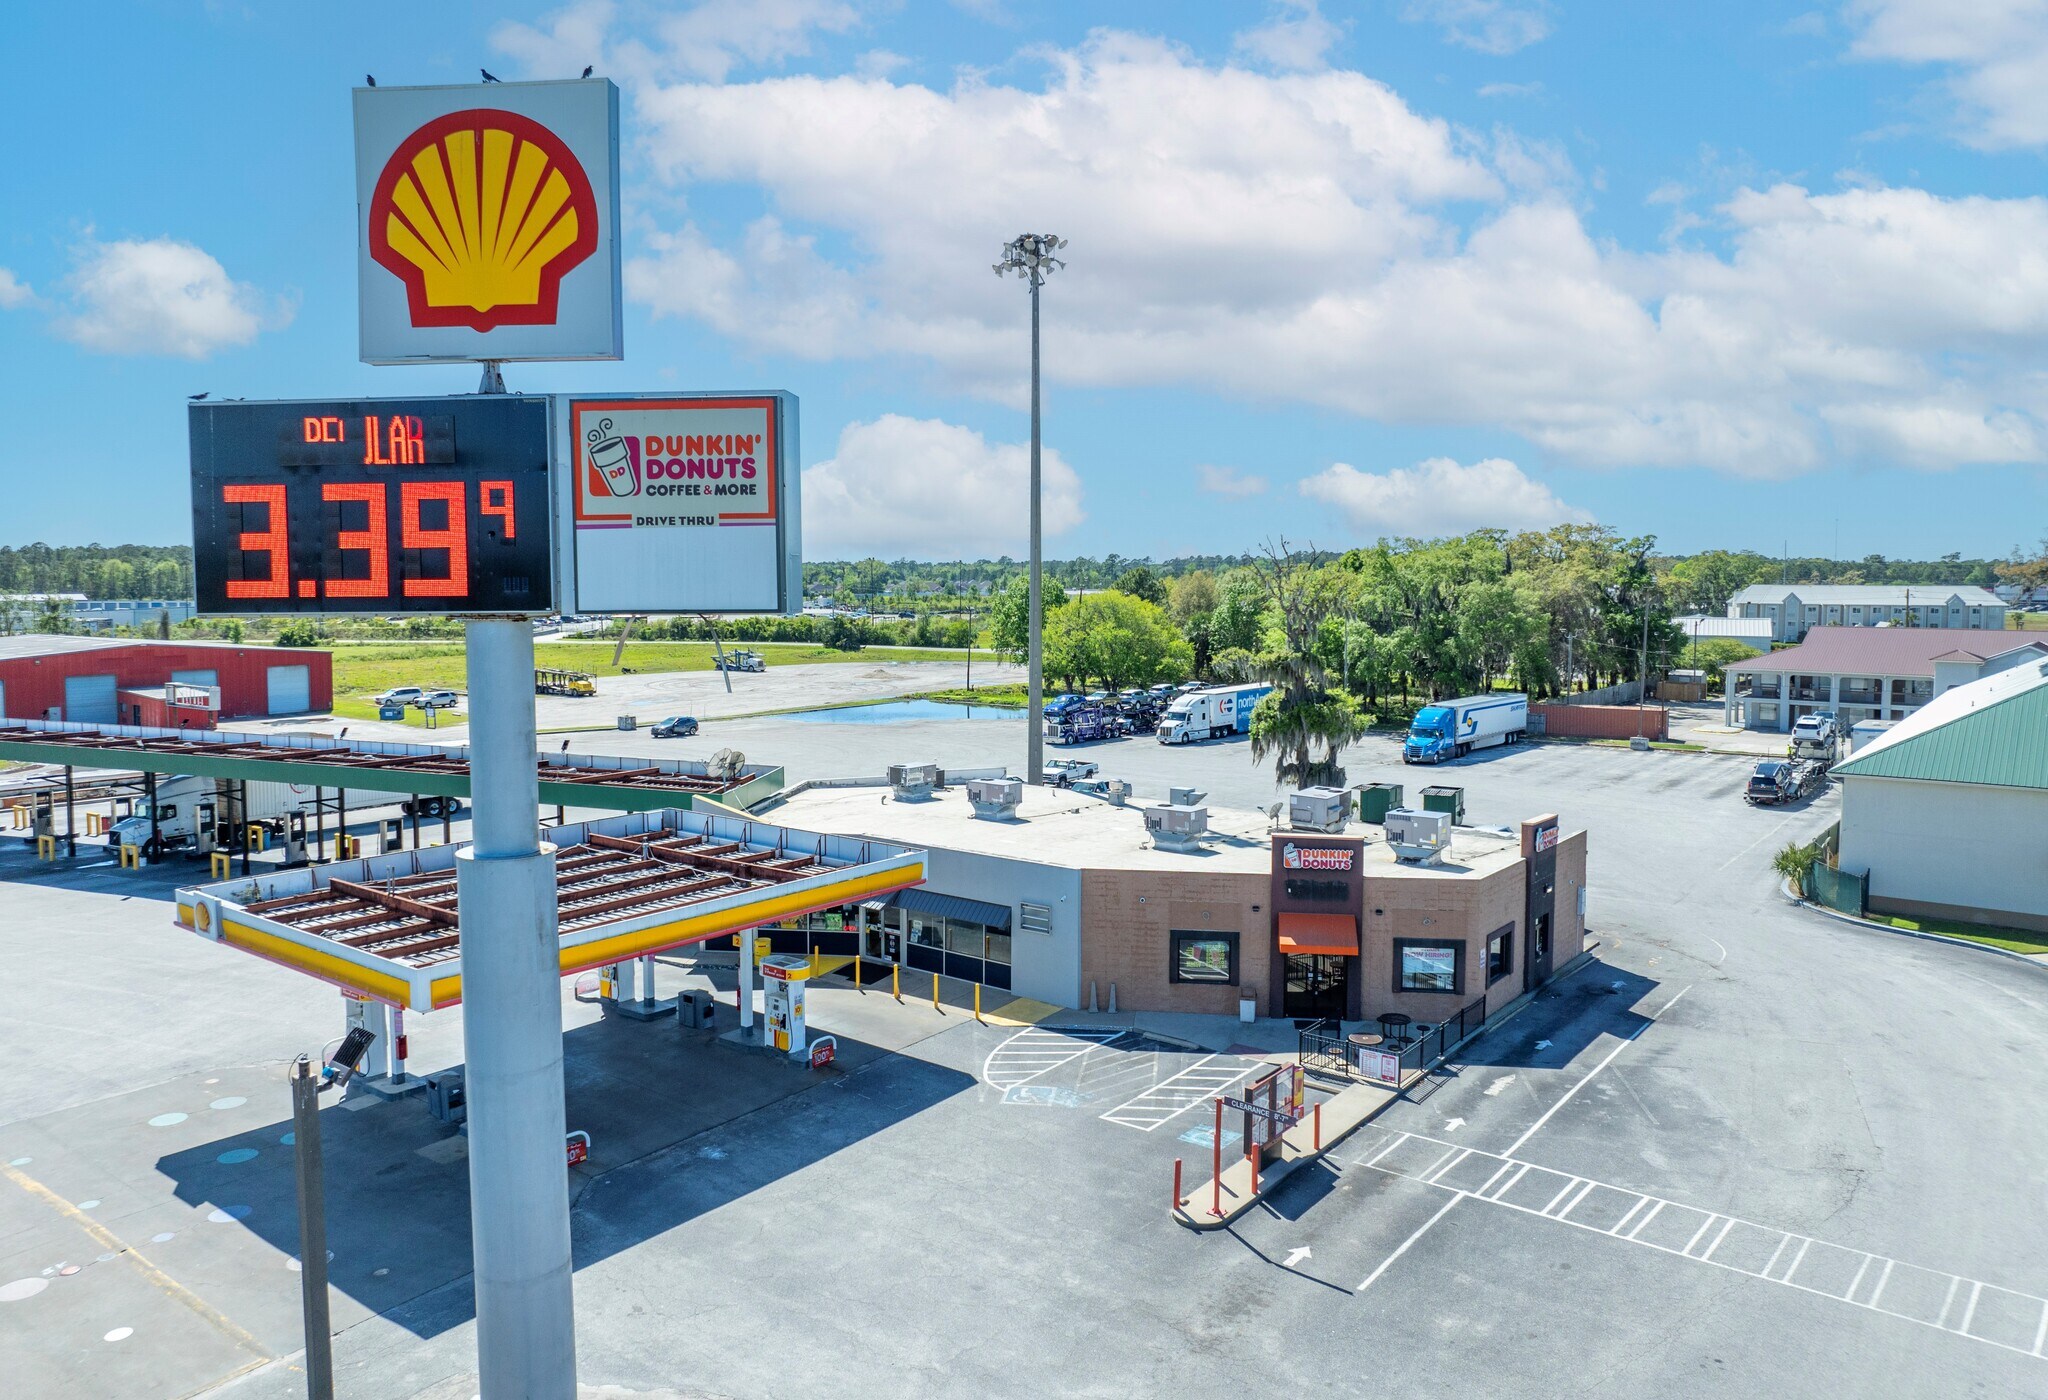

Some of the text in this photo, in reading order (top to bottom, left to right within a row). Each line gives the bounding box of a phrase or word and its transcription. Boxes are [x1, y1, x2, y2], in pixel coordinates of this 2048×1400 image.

[645, 434, 761, 457] DUNKIN'
[609, 466, 626, 479] DD
[646, 457, 757, 480] DONUTS
[645, 483, 757, 497] COFFEE & MORE
[636, 515, 715, 526] DRIVE THRU
[1302, 848, 1354, 860] DUNKIN'
[1302, 859, 1352, 870] DONUTS
[1231, 1100, 1271, 1118] CLEARANCE
